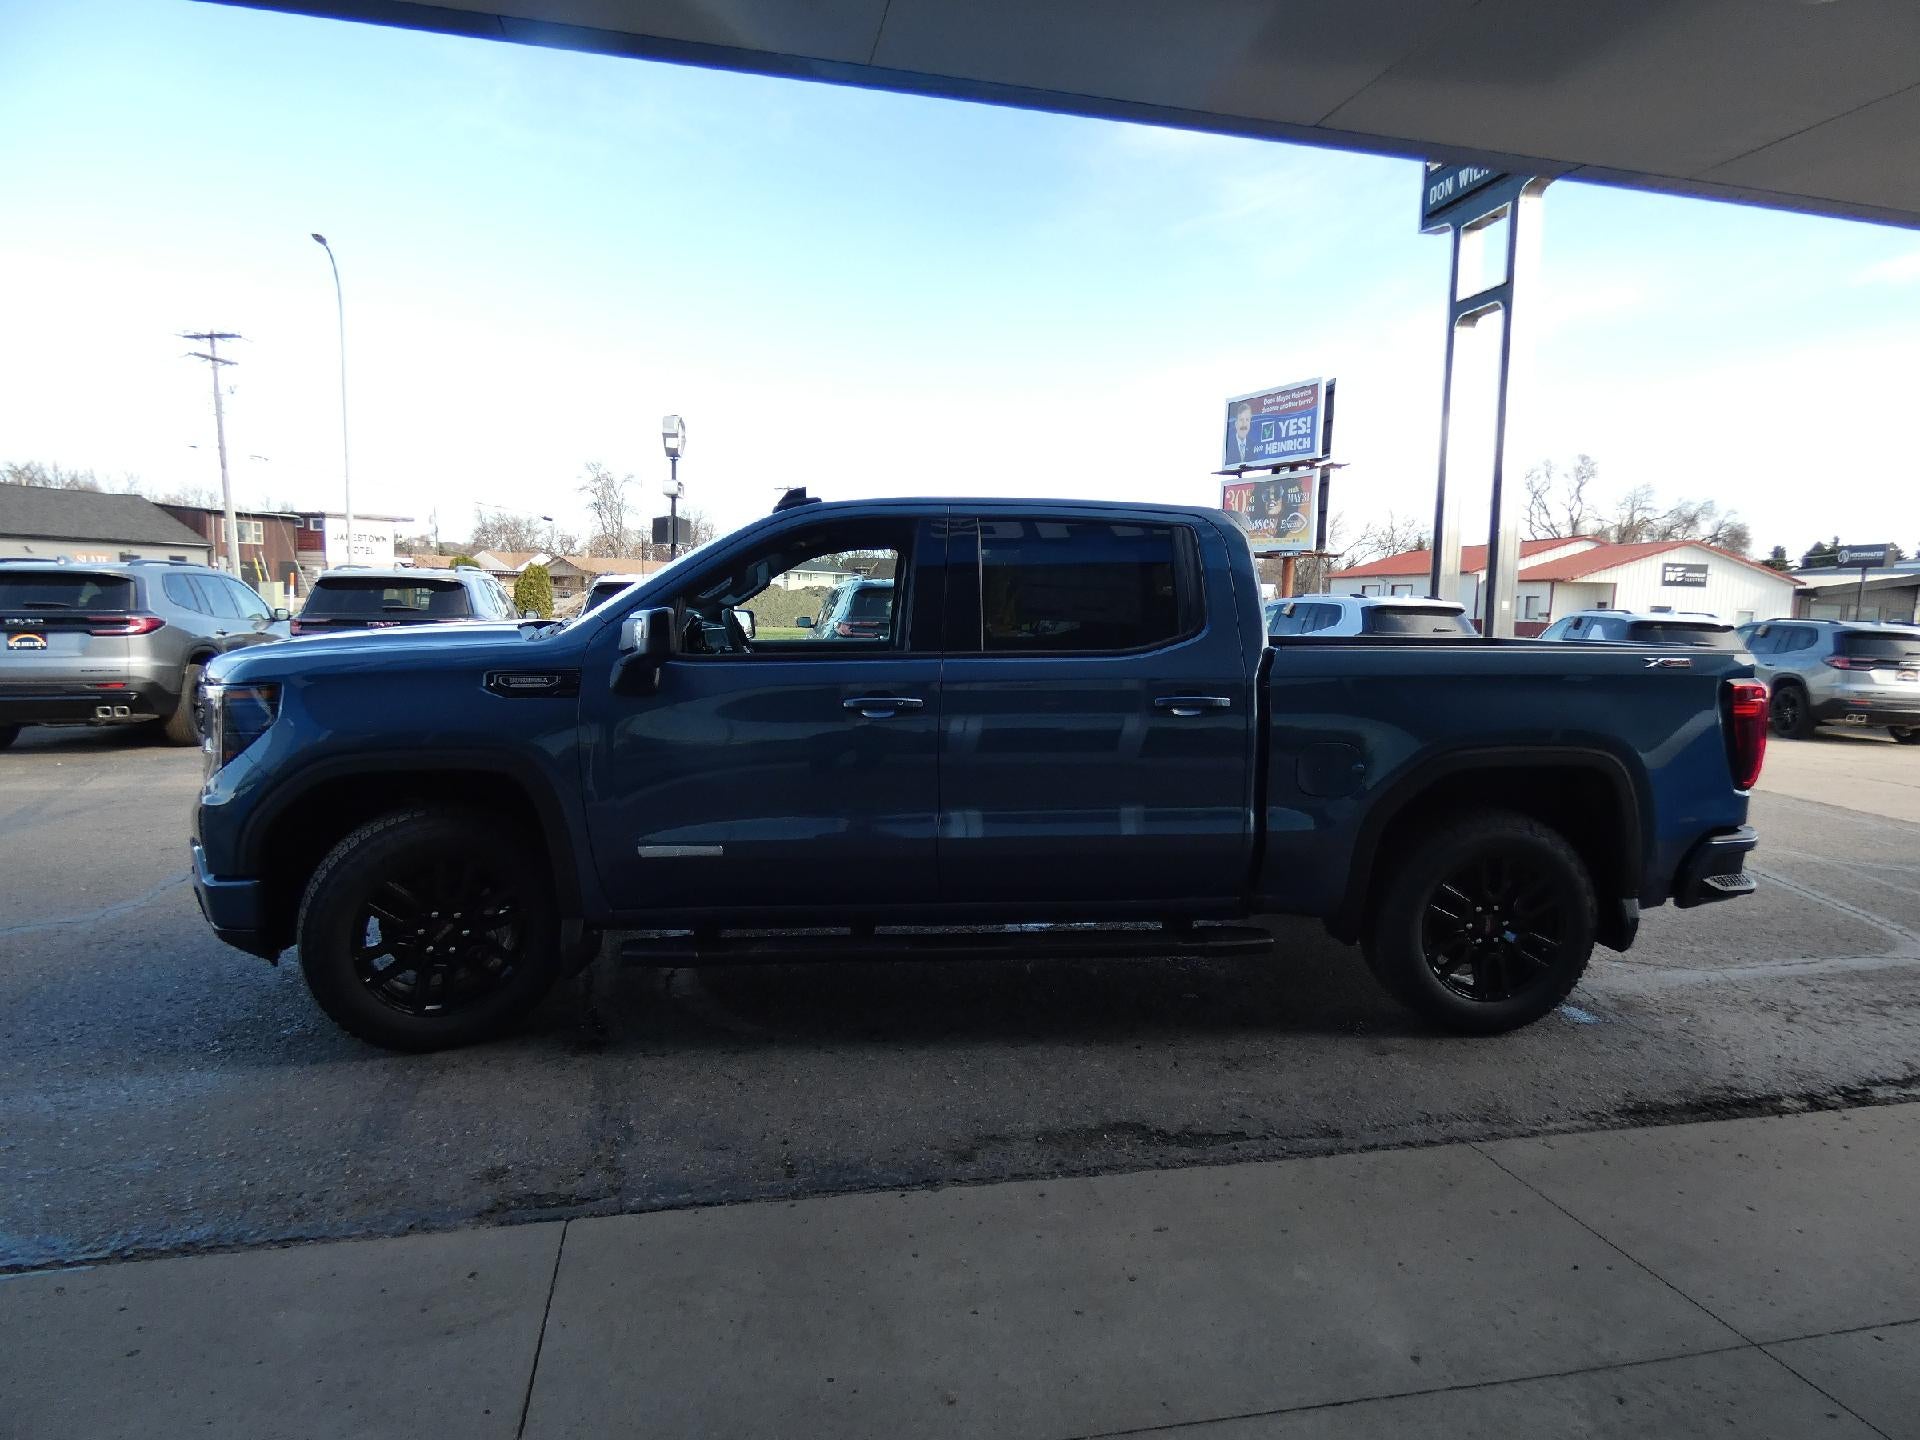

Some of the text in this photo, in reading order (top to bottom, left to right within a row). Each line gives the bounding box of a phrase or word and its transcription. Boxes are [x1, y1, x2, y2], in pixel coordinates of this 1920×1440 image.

[1429, 176, 1453, 205] DON
[1278, 415, 1312, 438] YES!
[1265, 436, 1311, 455] HEINRICH
